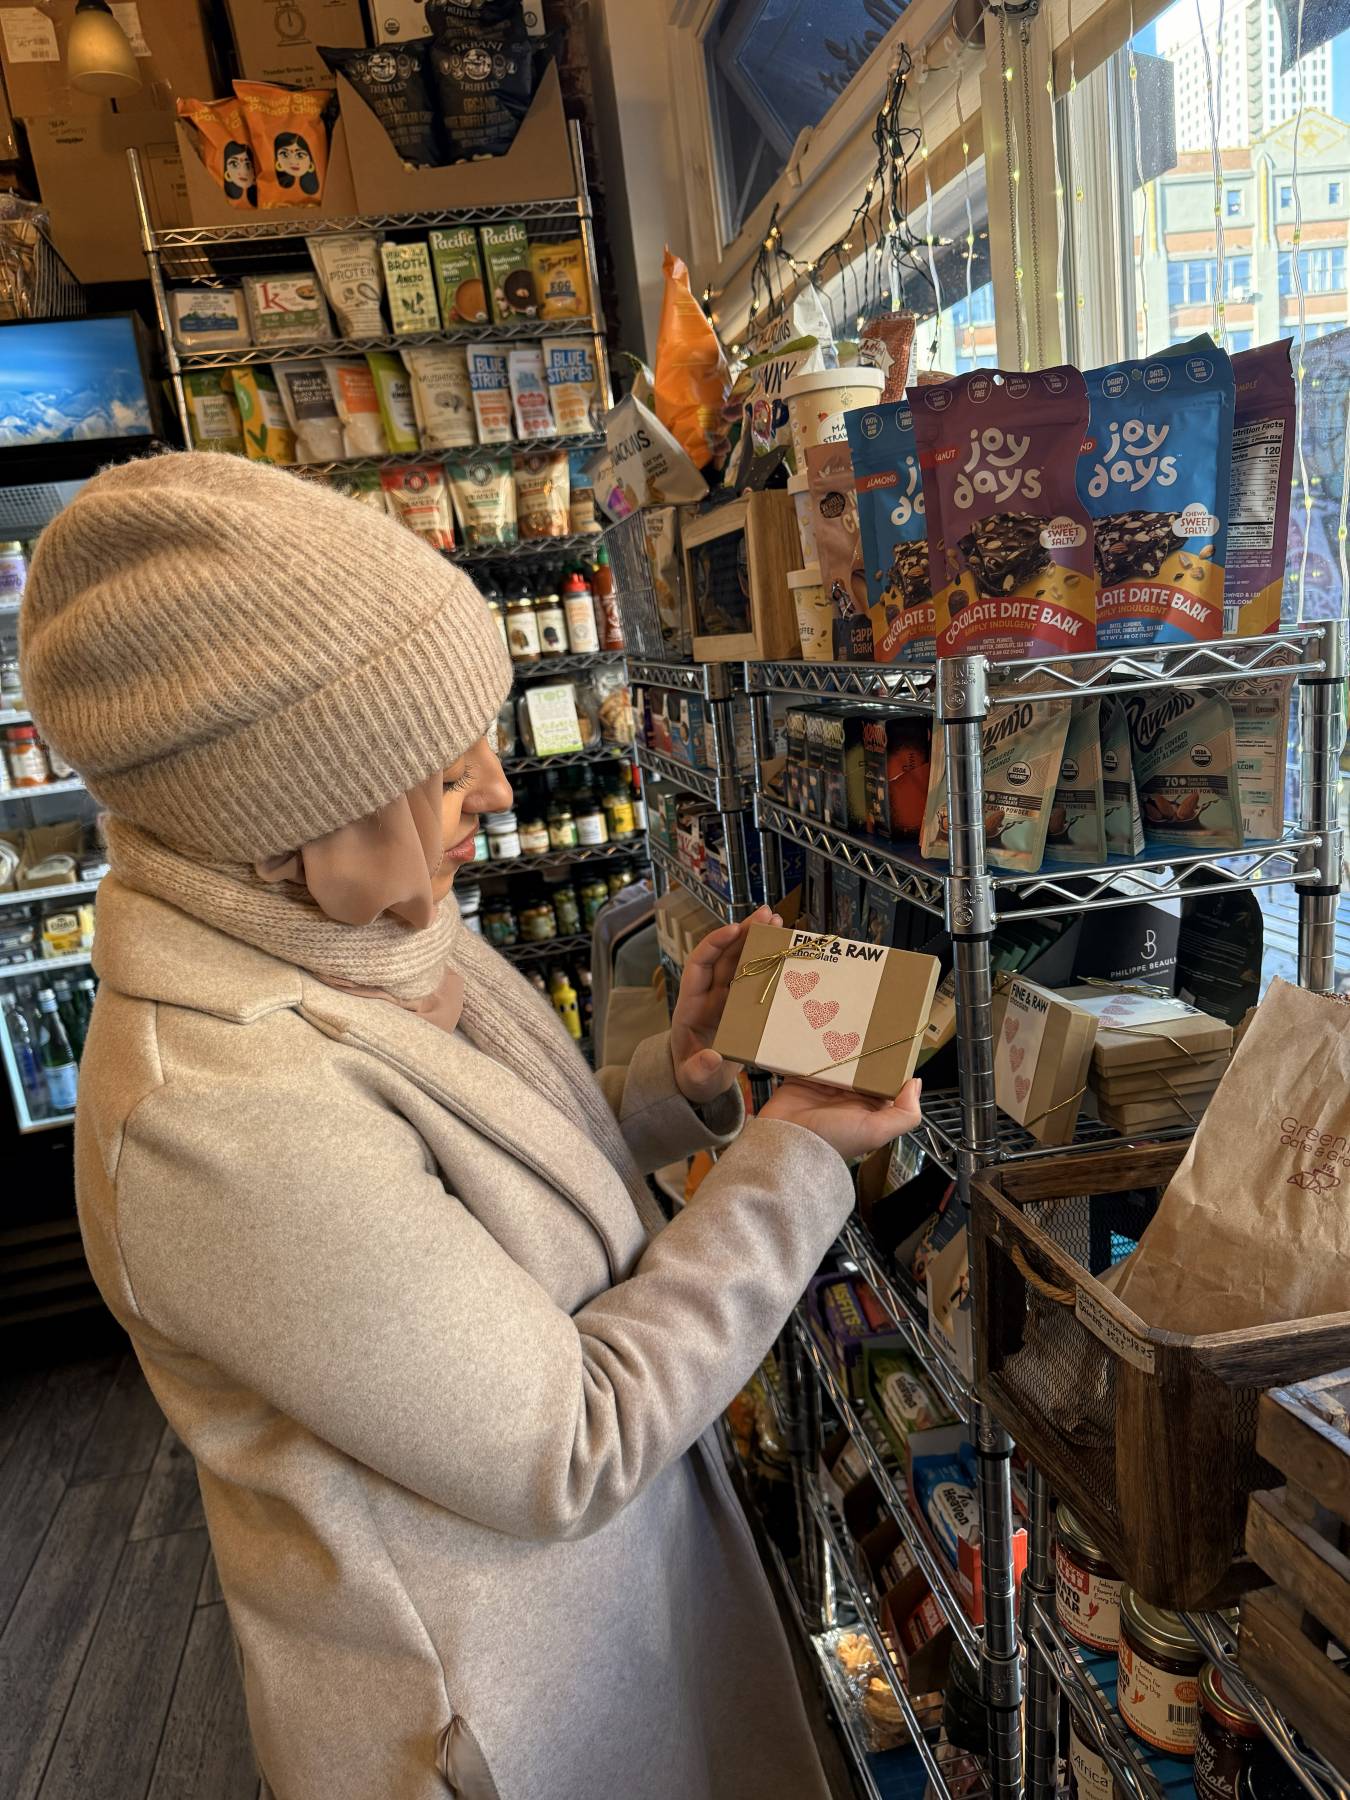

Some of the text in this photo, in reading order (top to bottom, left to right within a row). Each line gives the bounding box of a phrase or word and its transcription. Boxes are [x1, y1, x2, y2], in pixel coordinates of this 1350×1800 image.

[459, 79, 501, 91] TRUFFLES
[430, 229, 476, 251] Pacific
[480, 224, 528, 246] Pacific
[387, 257, 427, 272] BROTH
[330, 266, 377, 282] PROTEIN
[475, 356, 506, 373] BLUE
[553, 351, 584, 366] BLUE
[470, 372, 509, 390] STRIPE
[547, 366, 593, 383] STRIPES
[1232, 421, 1284, 438] utrition Facts
[1103, 419, 1170, 464] joy
[964, 427, 1031, 474] joy
[1264, 446, 1281, 455] 120
[1087, 454, 1179, 499] days
[953, 468, 1042, 509] days
[1180, 516, 1211, 528] SWEET
[1183, 525, 1208, 535] SALTY
[1047, 527, 1080, 539] SWEET
[1051, 536, 1076, 546] SALTY
[1094, 587, 1213, 624] LATE DATE BARK
[799, 626, 815, 636] FFEE
[882, 608, 925, 652] CHOCOLATE
[945, 602, 998, 645] CHOCOLATE
[1000, 602, 1040, 621] DATE
[1040, 607, 1084, 637] BARK
[989, 619, 1038, 632] INDULGENT
[1012, 767, 1027, 775] USDA
[1006, 807, 1029, 817] POWDER
[829, 941, 842, 956] &
[845, 943, 885, 963] RAW
[1110, 964, 1148, 978] PHILIPPE
[1149, 956, 1177, 970] BEAULI
[1011, 983, 1027, 1002] FINE
[1031, 995, 1049, 1015] RAW
[943, 1487, 970, 1526] Heaven
